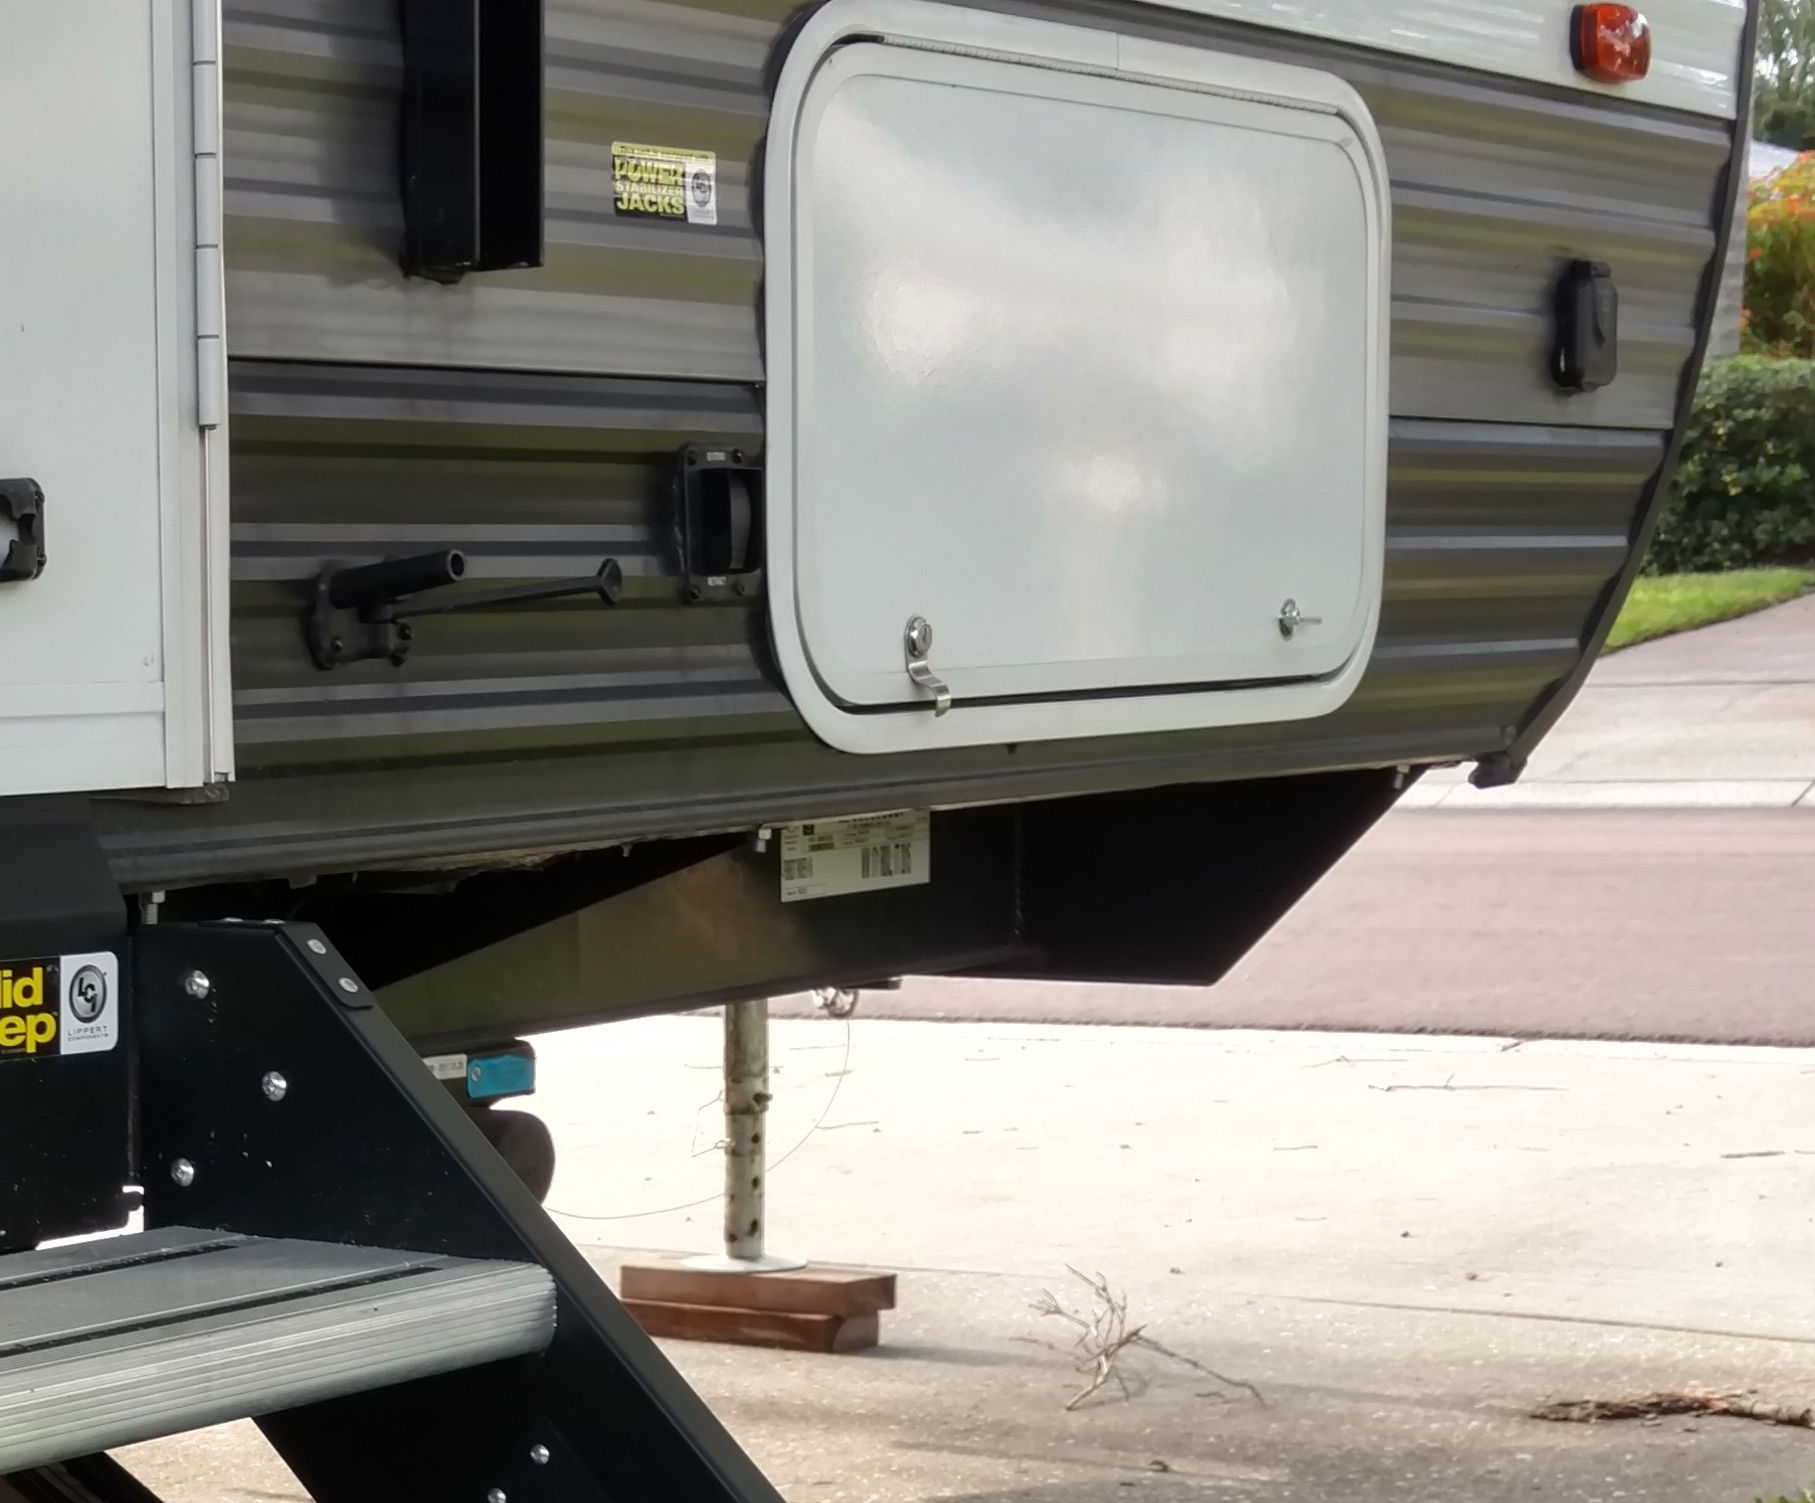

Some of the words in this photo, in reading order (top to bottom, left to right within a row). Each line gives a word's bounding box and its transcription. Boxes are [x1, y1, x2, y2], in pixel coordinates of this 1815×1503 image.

[615, 158, 684, 185] POWER
[616, 181, 683, 196] STABILIZER
[617, 193, 685, 214] JACKS
[68, 1025, 108, 1037] LIPPERT
